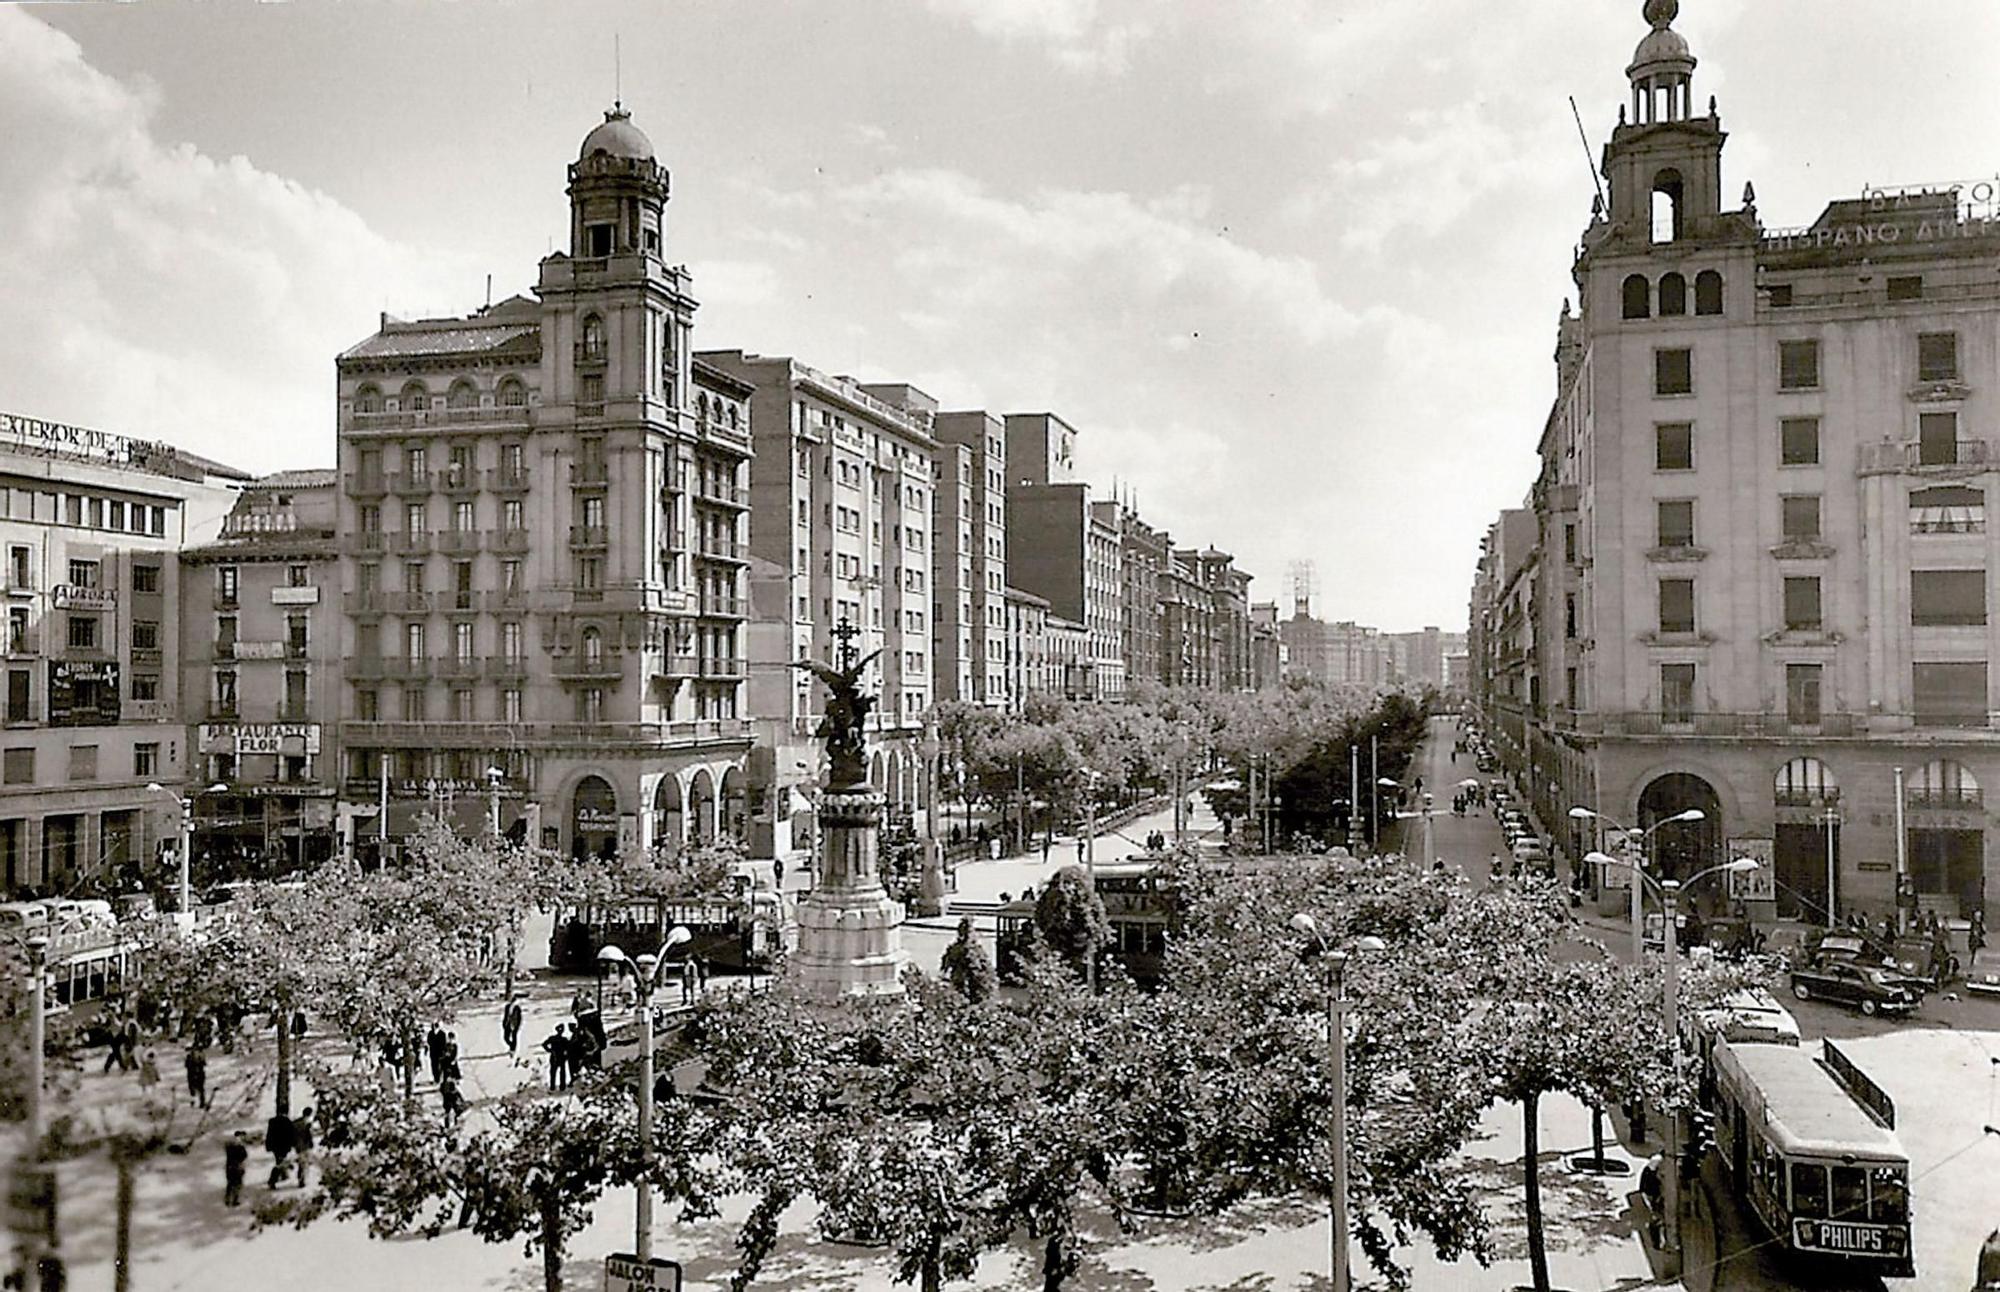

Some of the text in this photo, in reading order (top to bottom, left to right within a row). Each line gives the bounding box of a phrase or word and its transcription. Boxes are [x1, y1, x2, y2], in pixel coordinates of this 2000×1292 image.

[1871, 183, 1993, 211] BANCO
[1767, 222, 1900, 249] HISPANO
[0, 413, 79, 445] EXTERIOR
[240, 739, 278, 751] FLOR
[1821, 1225, 1882, 1250] PHILIPS
[609, 1261, 655, 1284] JALON
